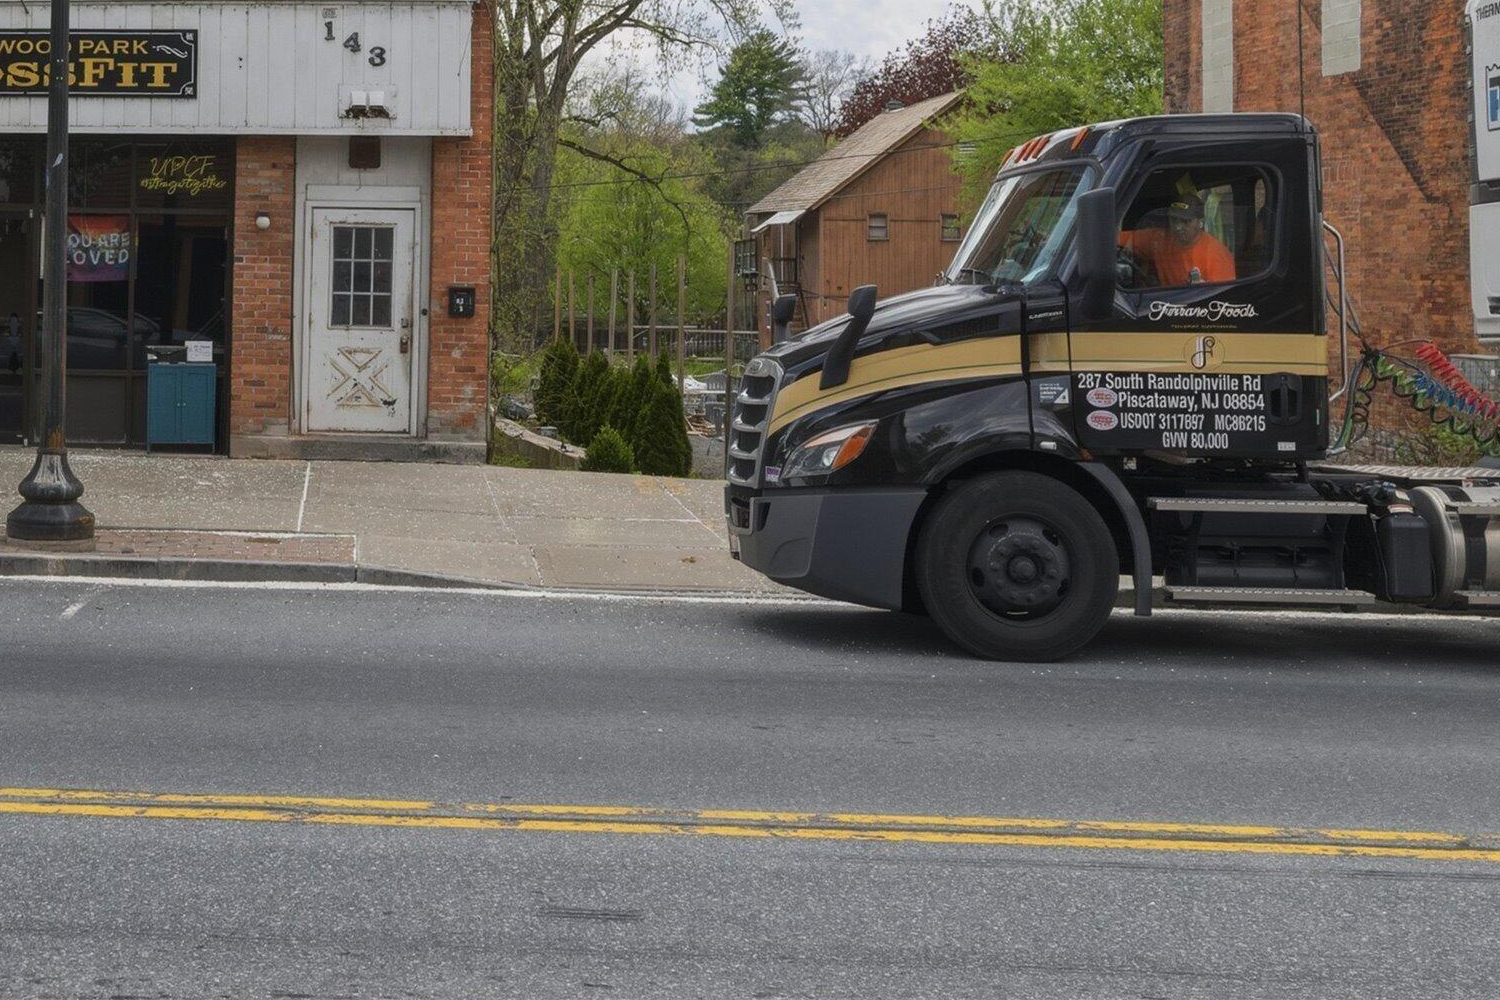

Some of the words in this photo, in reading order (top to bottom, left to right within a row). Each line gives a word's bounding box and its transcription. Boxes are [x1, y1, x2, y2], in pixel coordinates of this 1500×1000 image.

[79, 39, 149, 54] PARK
[324, 21, 387, 67] 143
[68, 232, 92, 248] OU
[98, 232, 130, 248] ARE
[66, 248, 129, 265] OVED
[1207, 300, 1260, 321] Foods
[1077, 373, 1102, 389] 287
[1105, 373, 1144, 390] South
[1147, 373, 1239, 394] Randolphville
[1242, 374, 1261, 391] Rd
[1118, 391, 1198, 412] Piscataway,
[1201, 392, 1219, 409] NJ
[1222, 393, 1265, 411] 08854
[1120, 412, 1156, 429] USDOT
[1162, 431, 1188, 448] GVW
[1190, 432, 1229, 449] 80,000
